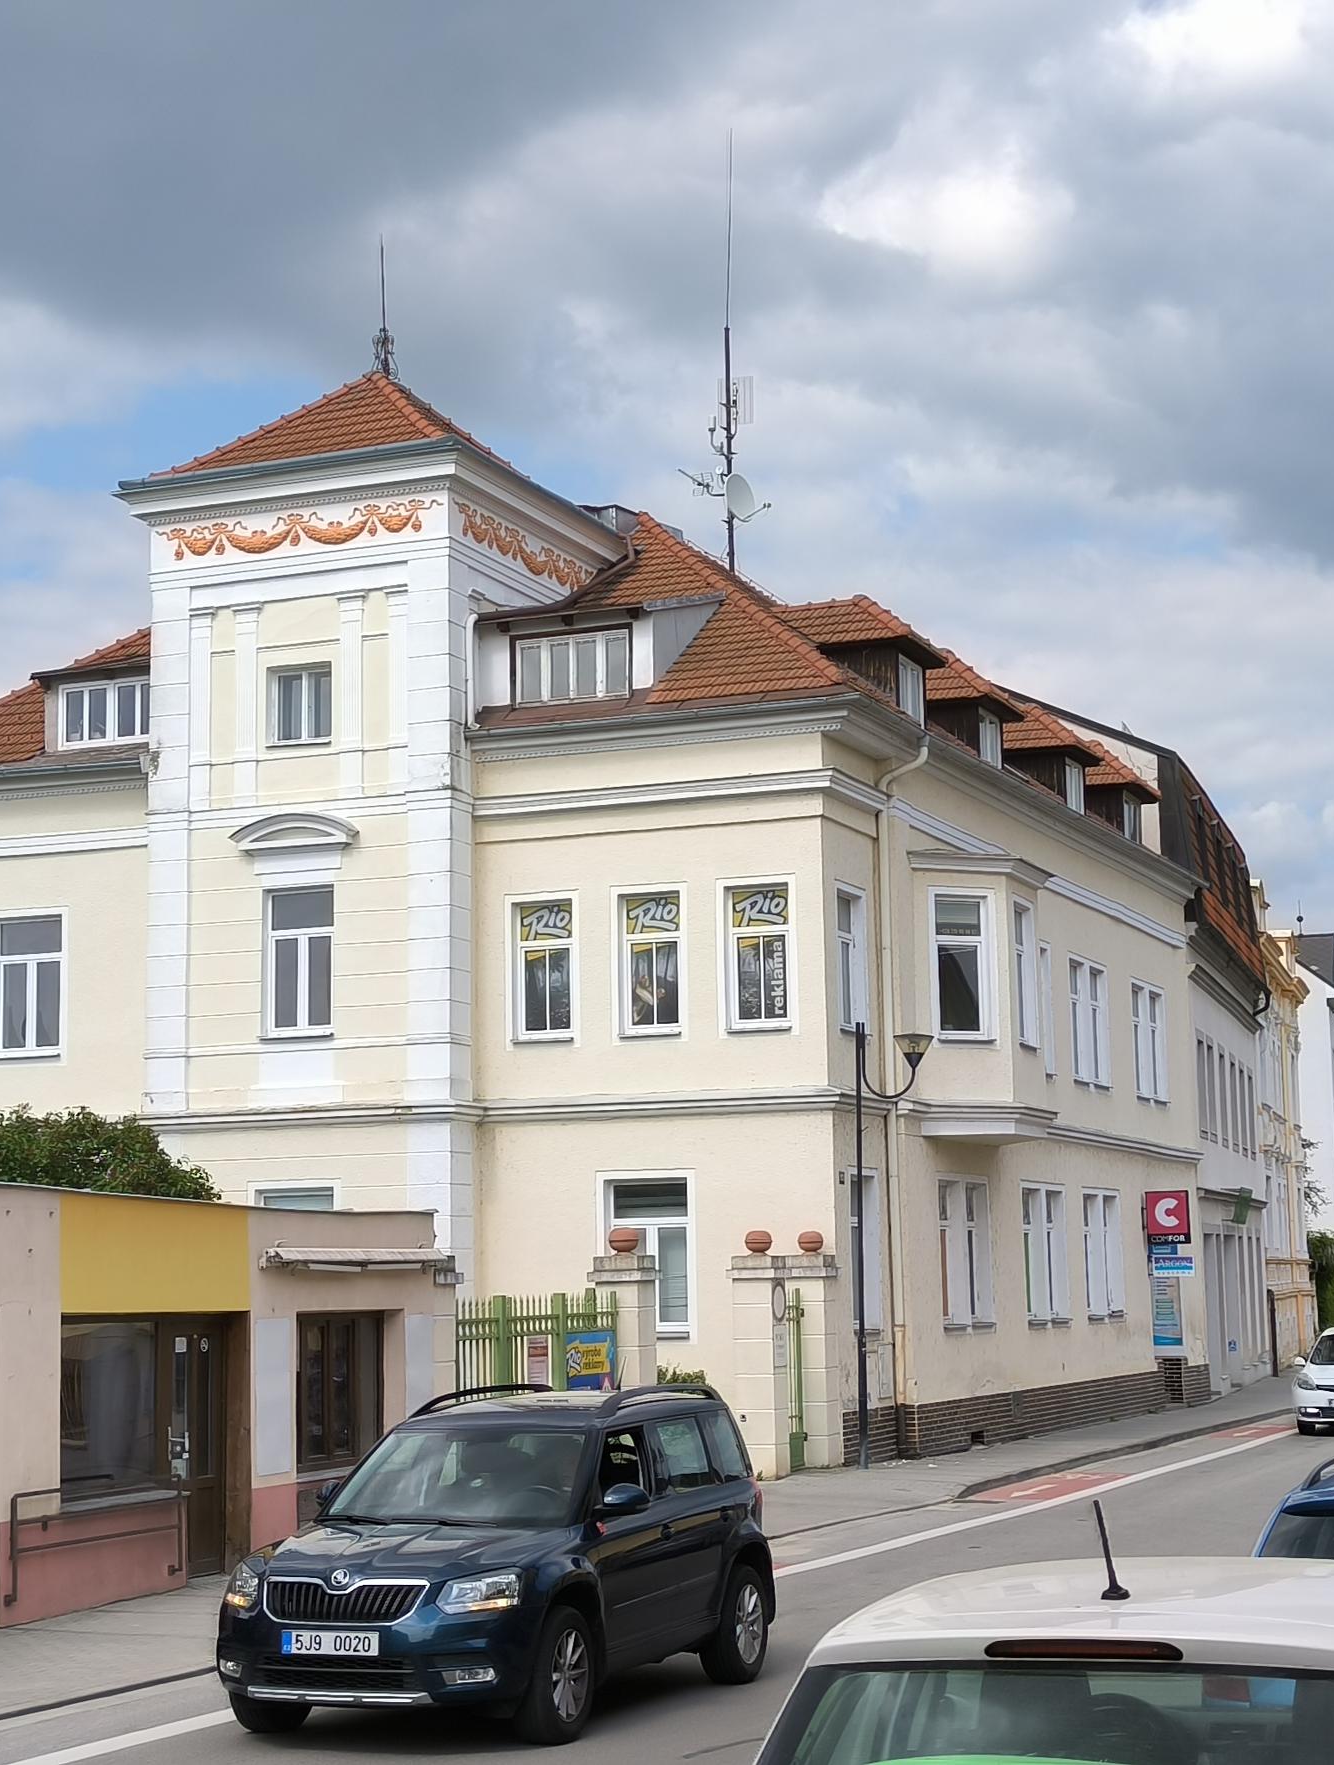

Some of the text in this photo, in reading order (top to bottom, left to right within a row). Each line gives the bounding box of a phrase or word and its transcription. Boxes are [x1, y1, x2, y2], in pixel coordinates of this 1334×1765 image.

[522, 905, 571, 941] Rio
[629, 899, 679, 933] Rio
[734, 891, 787, 927] Rio
[771, 941, 784, 1015] reklama
[1151, 1235, 1185, 1243] COMFOR
[295, 1634, 371, 1652] 5J9 0020
